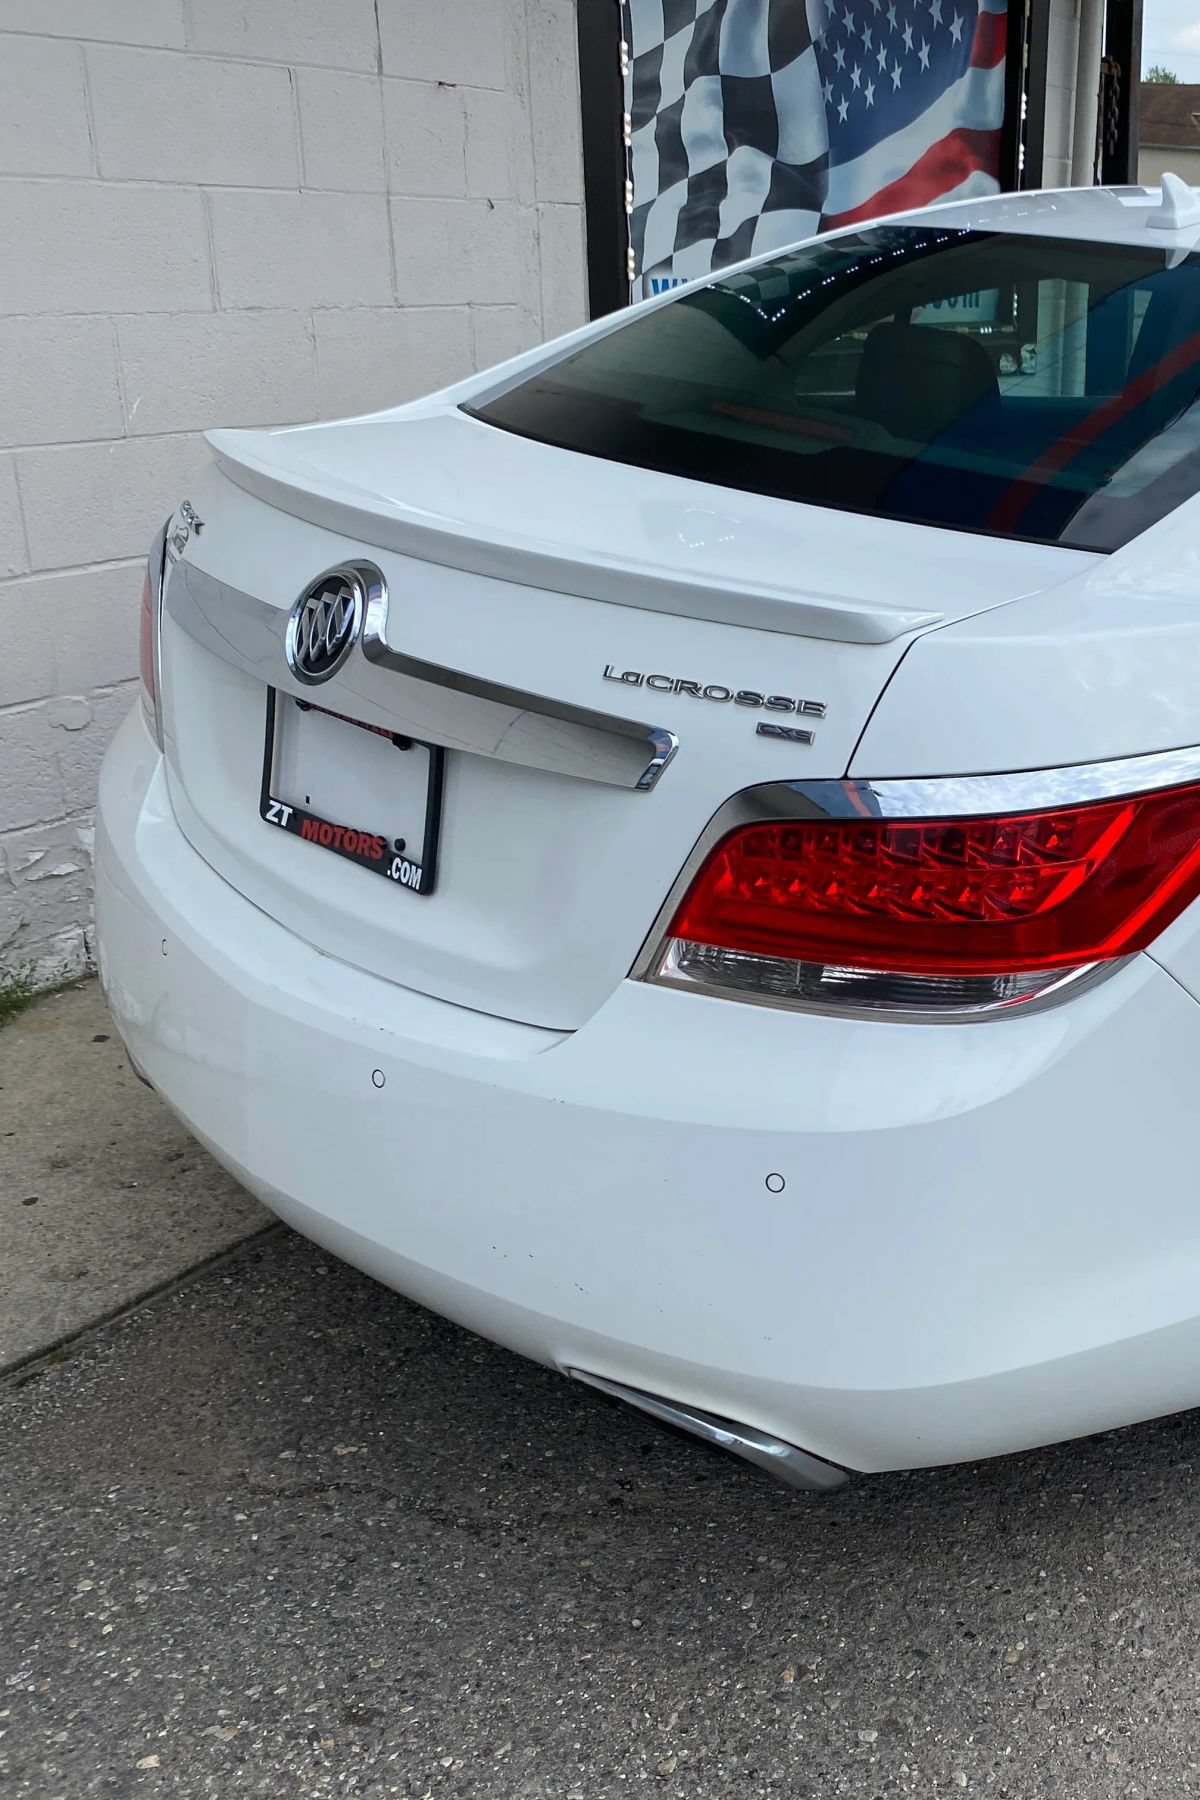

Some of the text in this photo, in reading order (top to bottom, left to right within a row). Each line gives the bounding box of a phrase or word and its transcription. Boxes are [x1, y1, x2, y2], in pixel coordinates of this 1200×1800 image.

[602, 664, 828, 719] LaCROSSE
[757, 722, 814, 744] CXS
[265, 800, 423, 890] ZT MOTORS .COM
